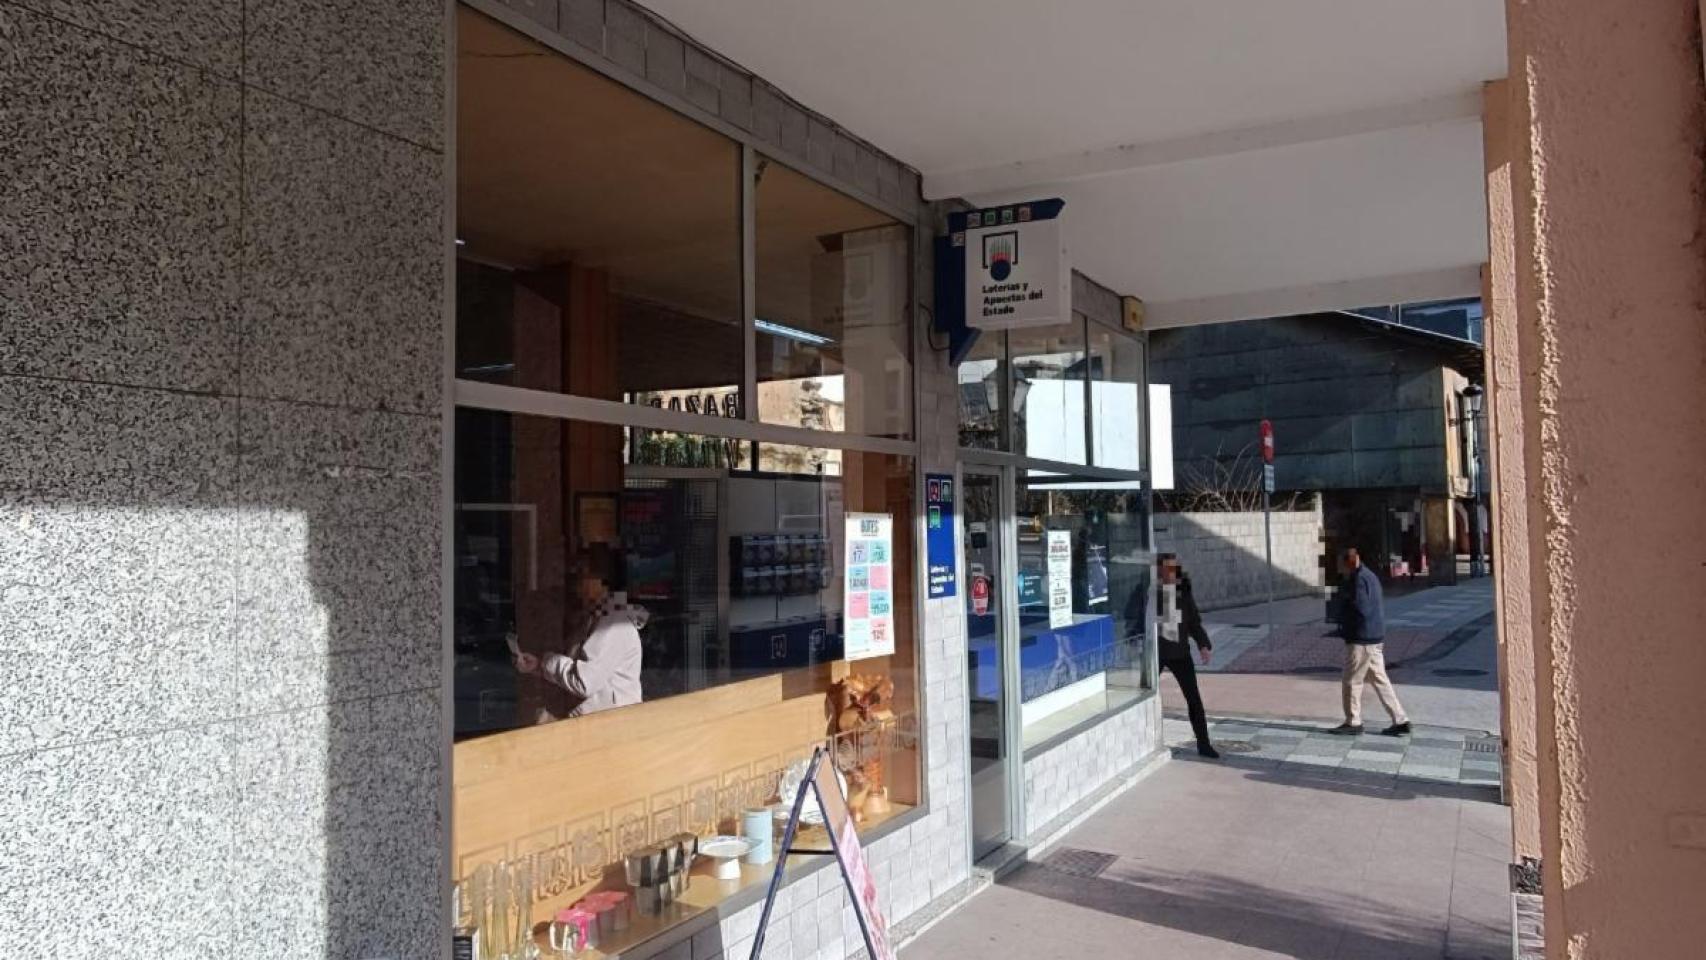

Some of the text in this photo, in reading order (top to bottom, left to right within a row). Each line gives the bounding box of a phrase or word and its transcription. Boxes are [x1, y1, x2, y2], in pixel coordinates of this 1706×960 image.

[983, 288, 1043, 305] Apuestas del
[983, 305, 1015, 316] Estado
